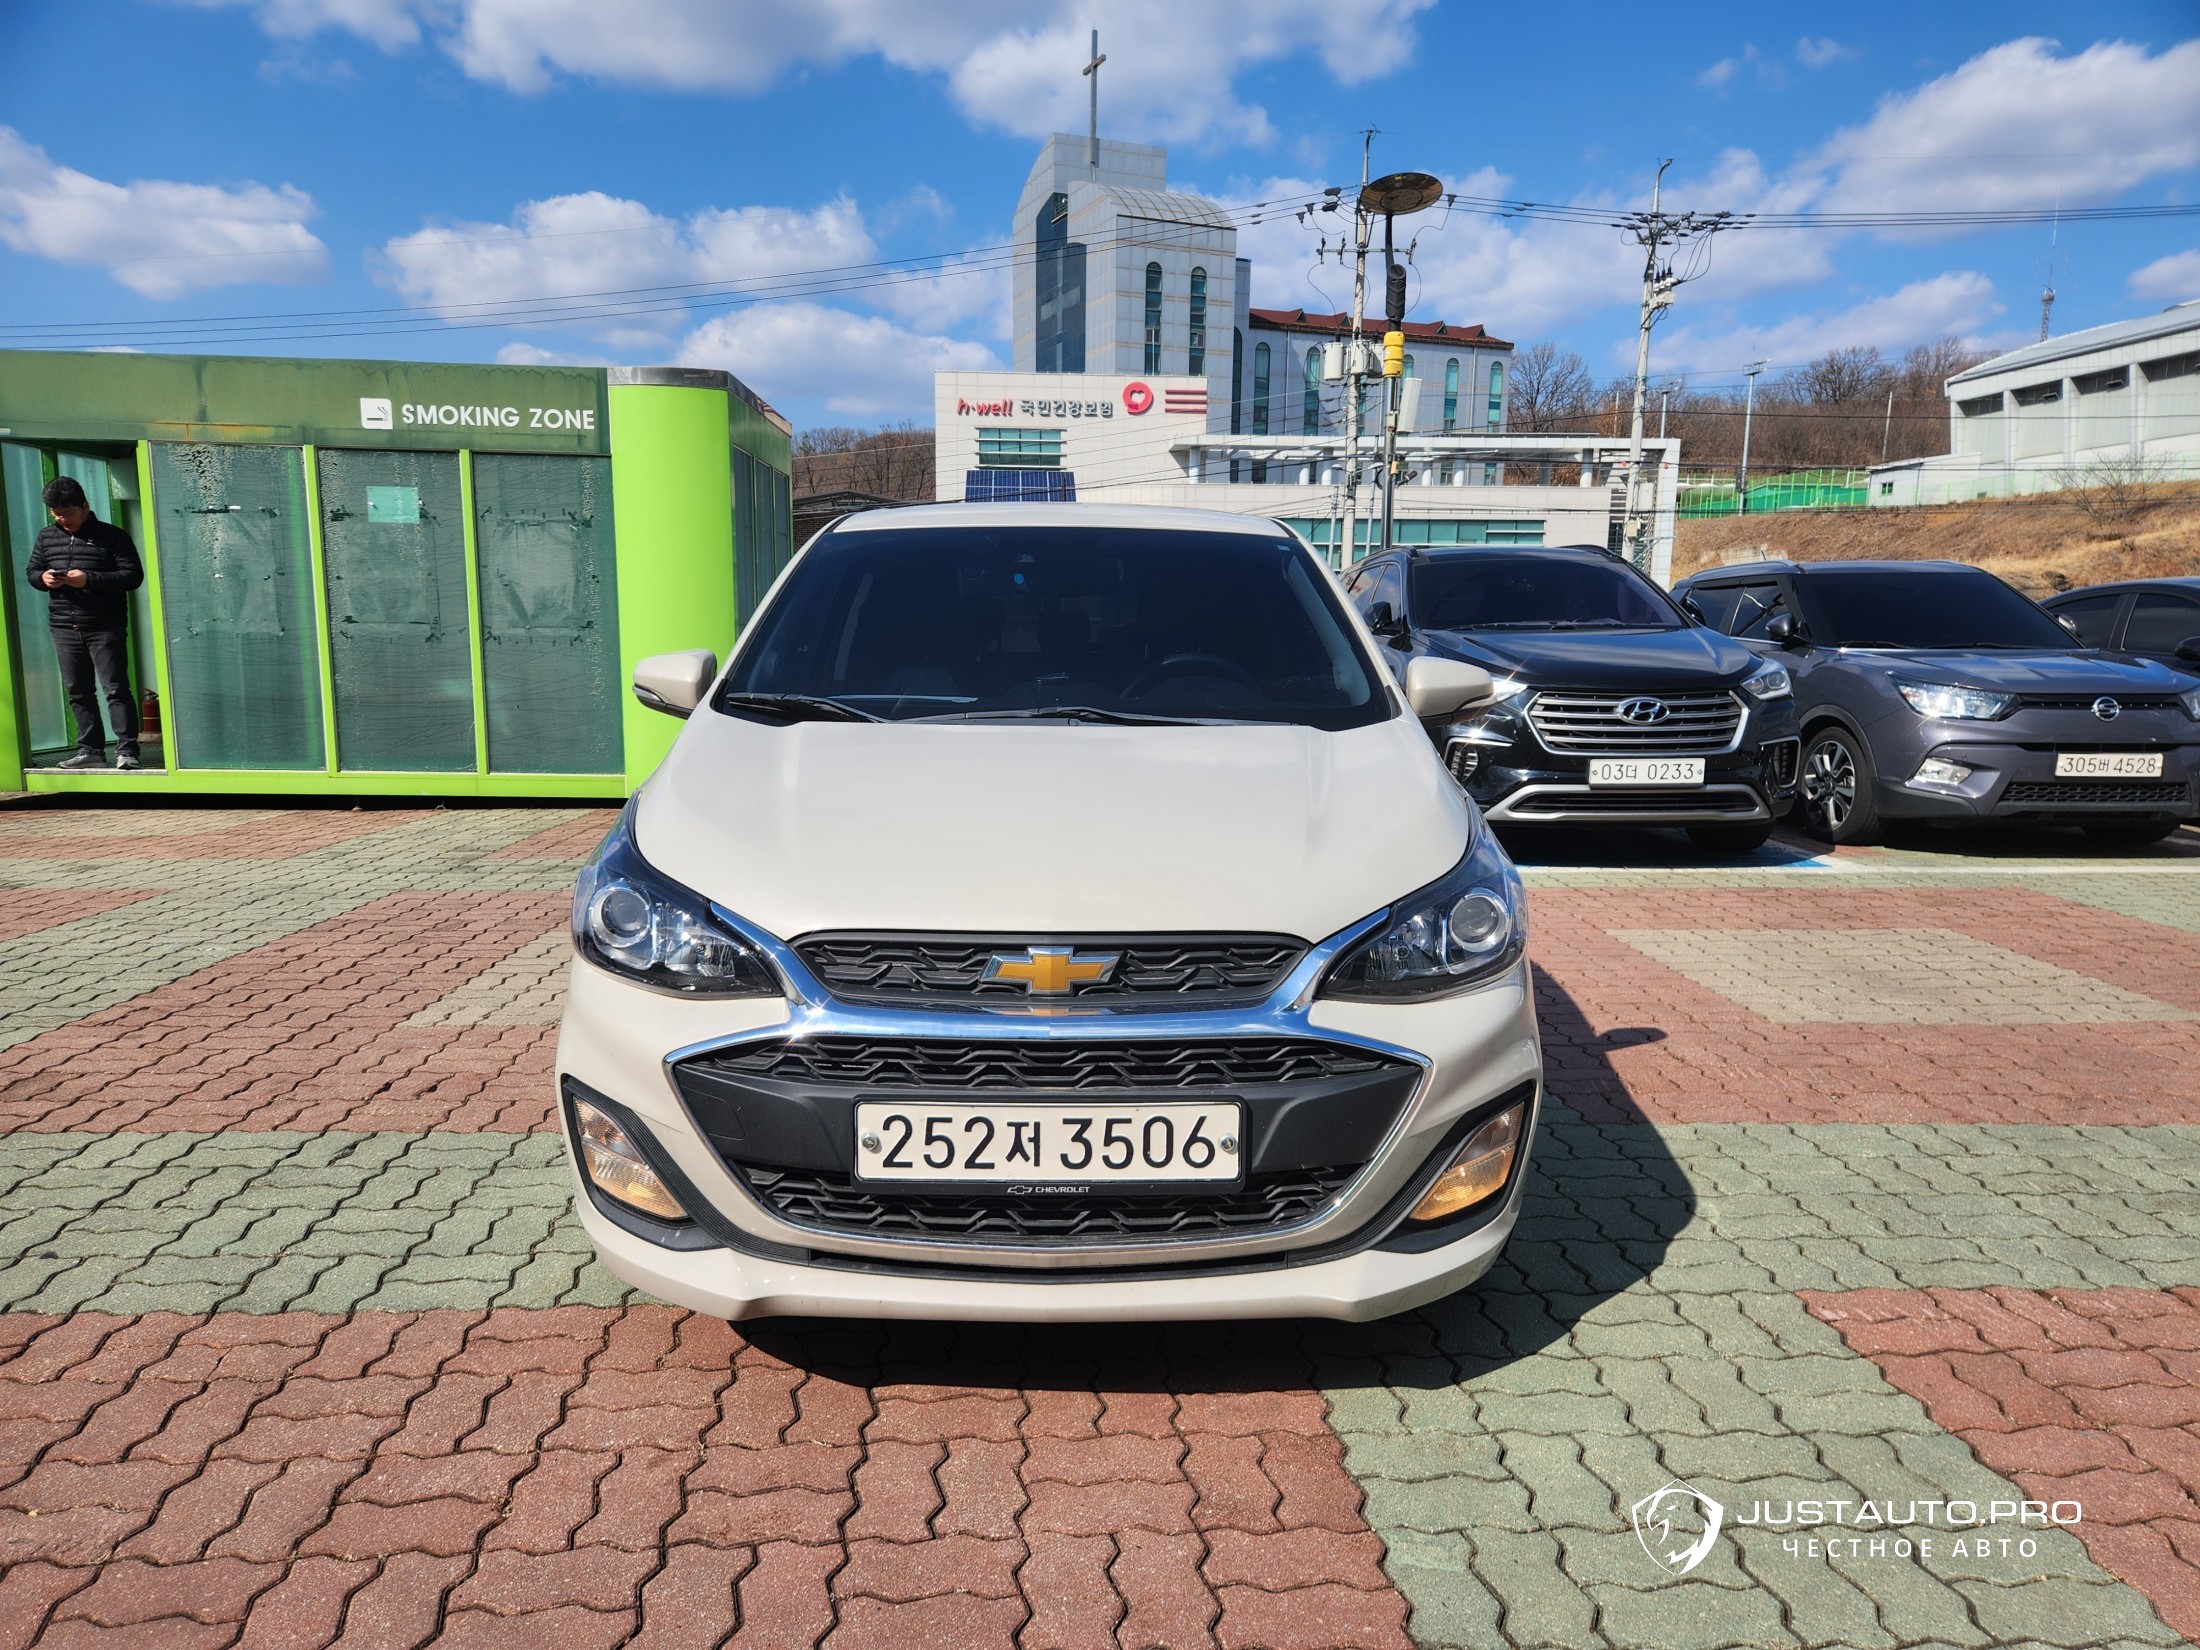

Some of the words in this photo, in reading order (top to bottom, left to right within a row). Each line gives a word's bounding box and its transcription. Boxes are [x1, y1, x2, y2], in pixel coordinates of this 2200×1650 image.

[401, 404, 520, 427] SMOKING
[529, 407, 595, 430] ZONE
[1021, 399, 1114, 418] 국민건강보험
[1601, 763, 1638, 780] 03더
[1647, 763, 1695, 780] 0233
[2063, 757, 2110, 773] 305버
[2113, 757, 2156, 774] 4528
[881, 1114, 1041, 1170] 252저
[1060, 1114, 1216, 1170] 3506
